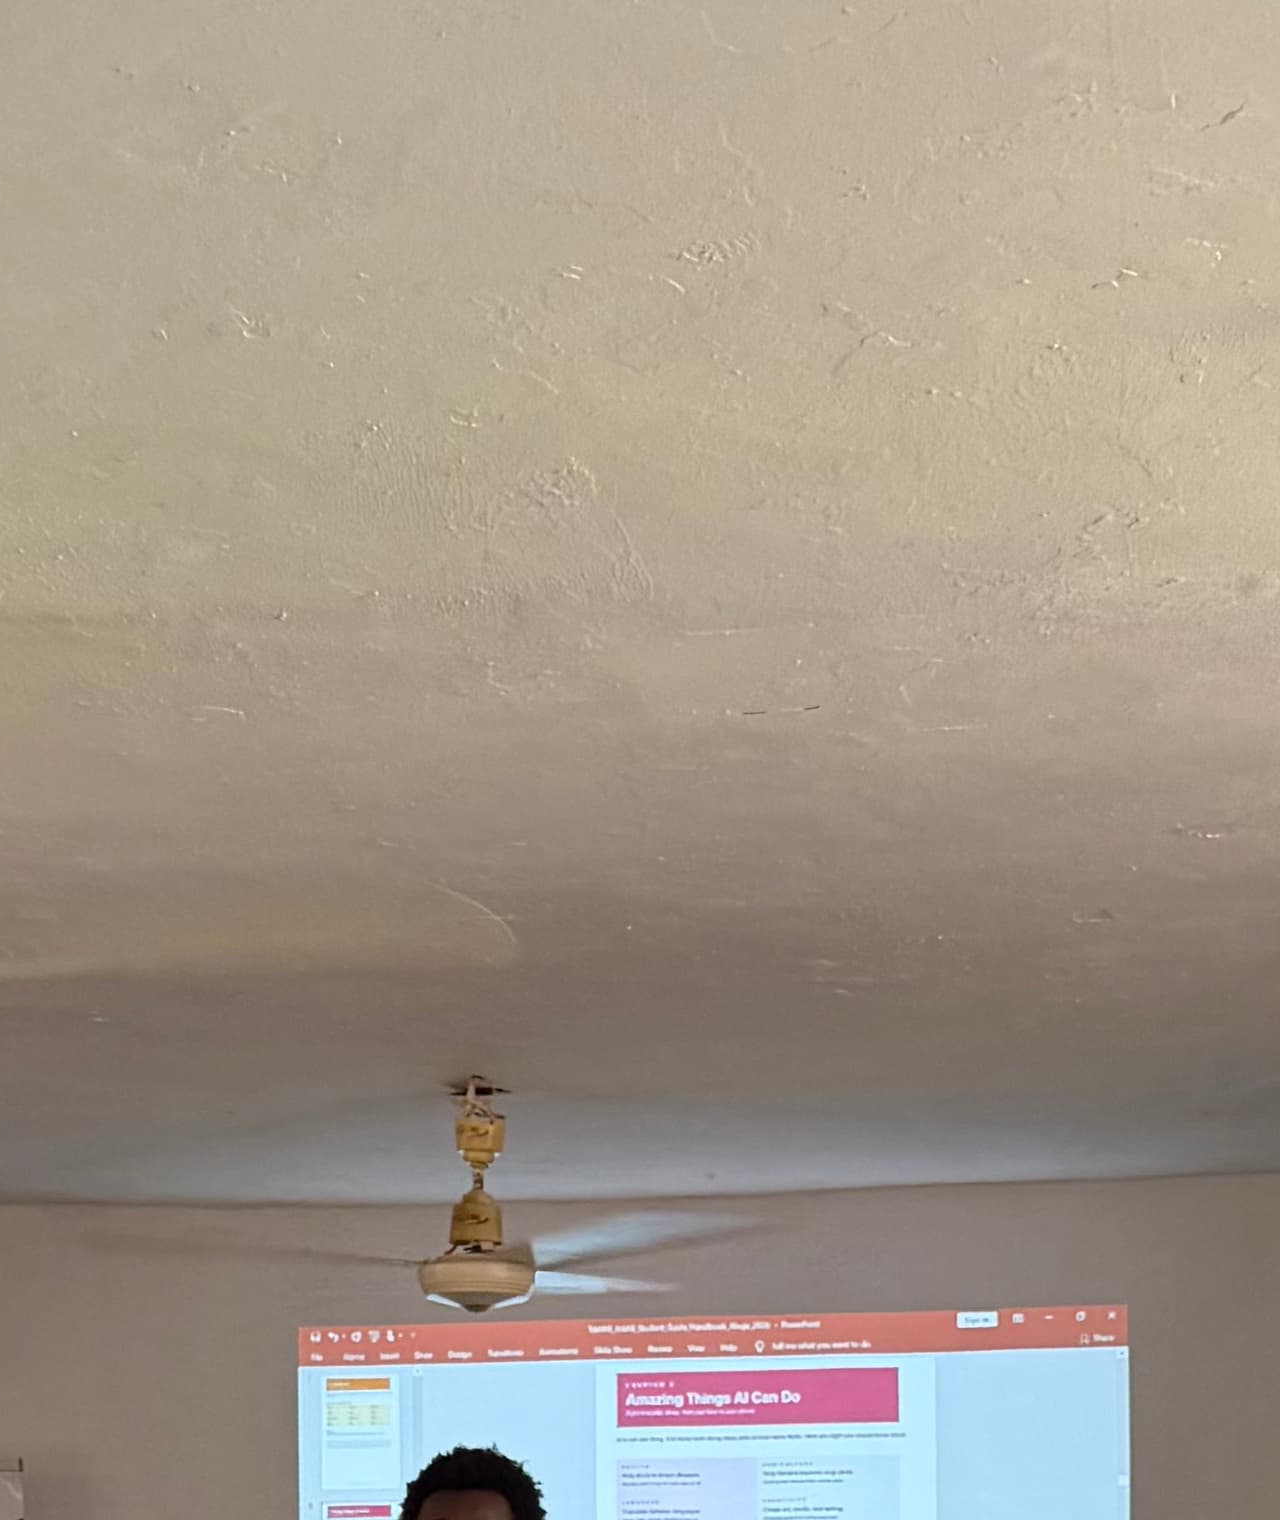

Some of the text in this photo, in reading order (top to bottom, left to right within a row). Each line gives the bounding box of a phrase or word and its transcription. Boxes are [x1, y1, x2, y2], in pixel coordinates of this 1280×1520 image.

[625, 1390, 801, 1408] Amazing Things AI Can Do
